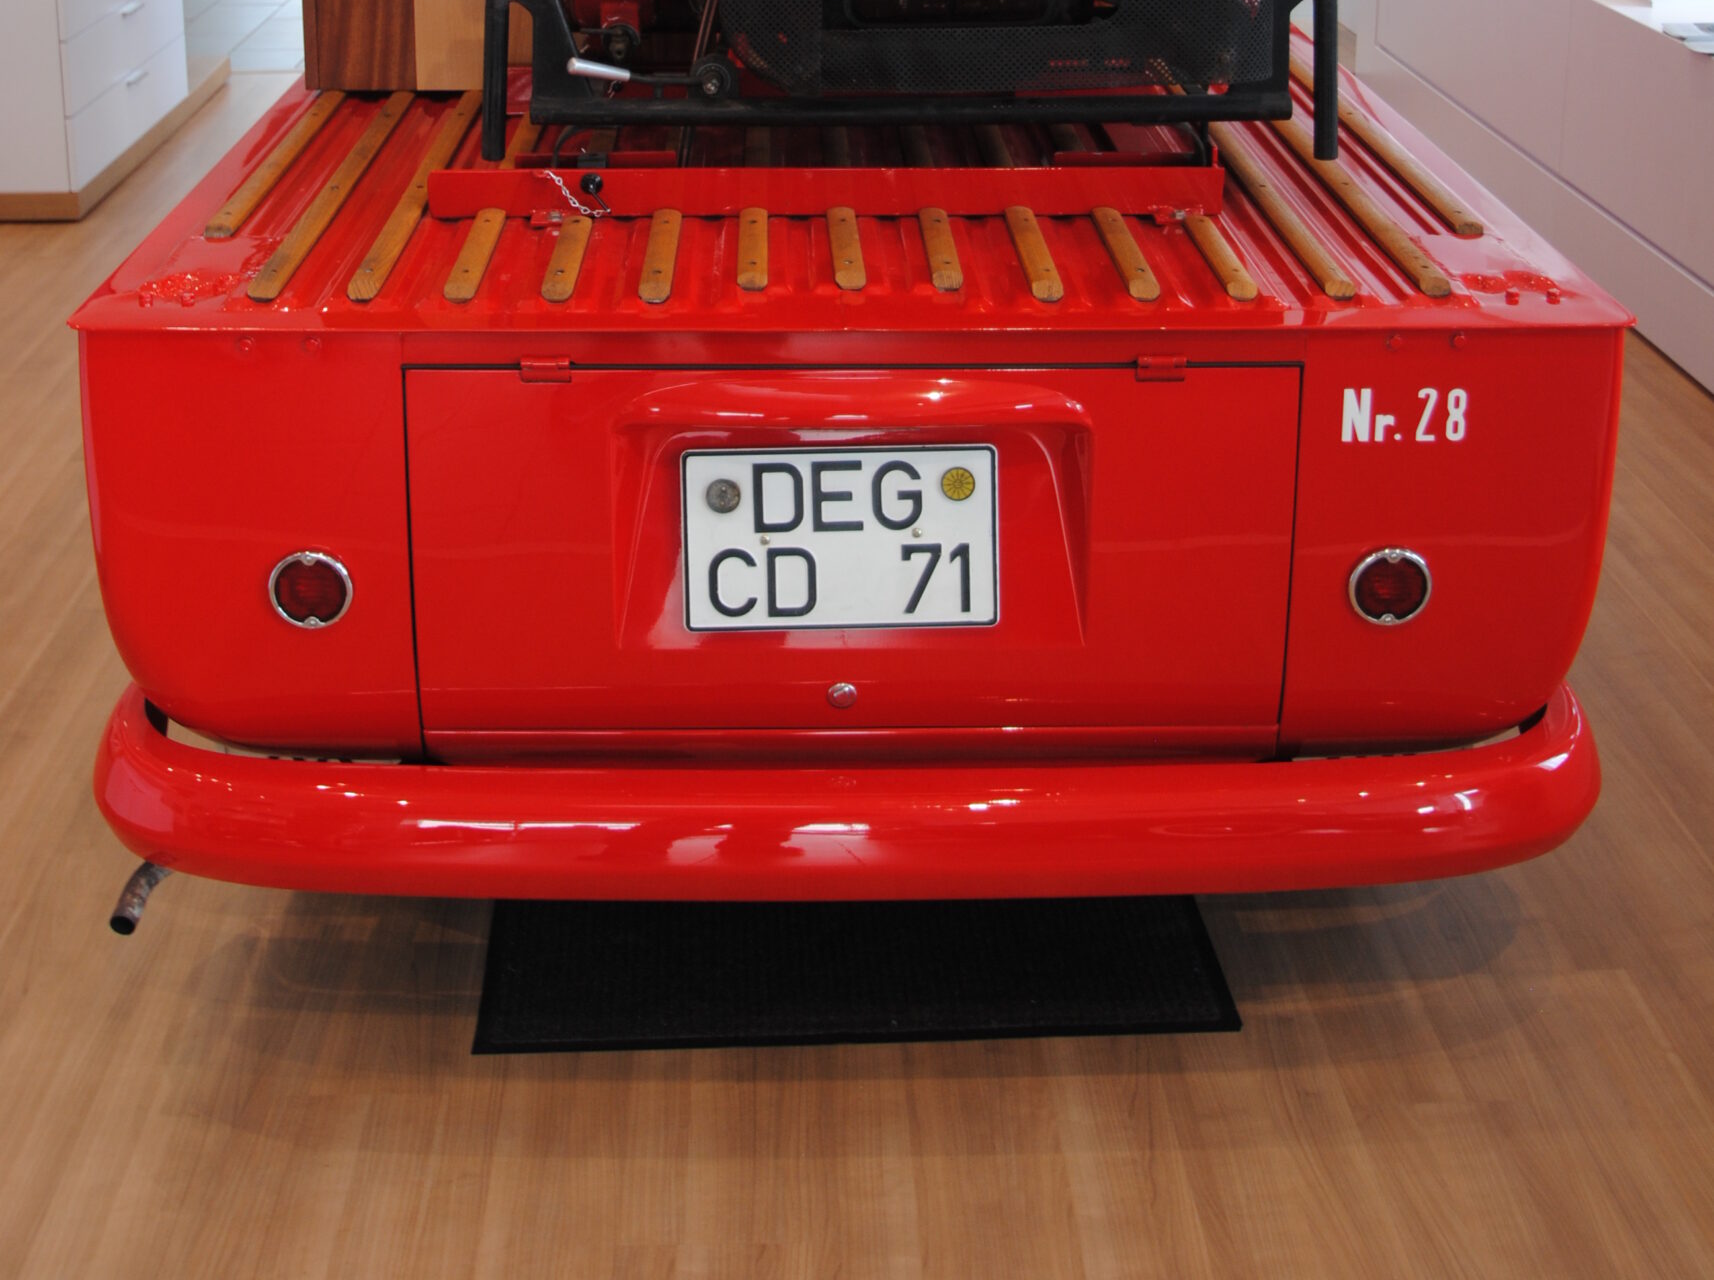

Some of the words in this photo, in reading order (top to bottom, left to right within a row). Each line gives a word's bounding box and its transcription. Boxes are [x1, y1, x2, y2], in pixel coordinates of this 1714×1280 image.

[1341, 388, 1402, 442] Nr.
[1415, 387, 1467, 442] 28
[752, 460, 922, 533] DEG
[708, 547, 817, 618] CD
[901, 543, 971, 614] 71
